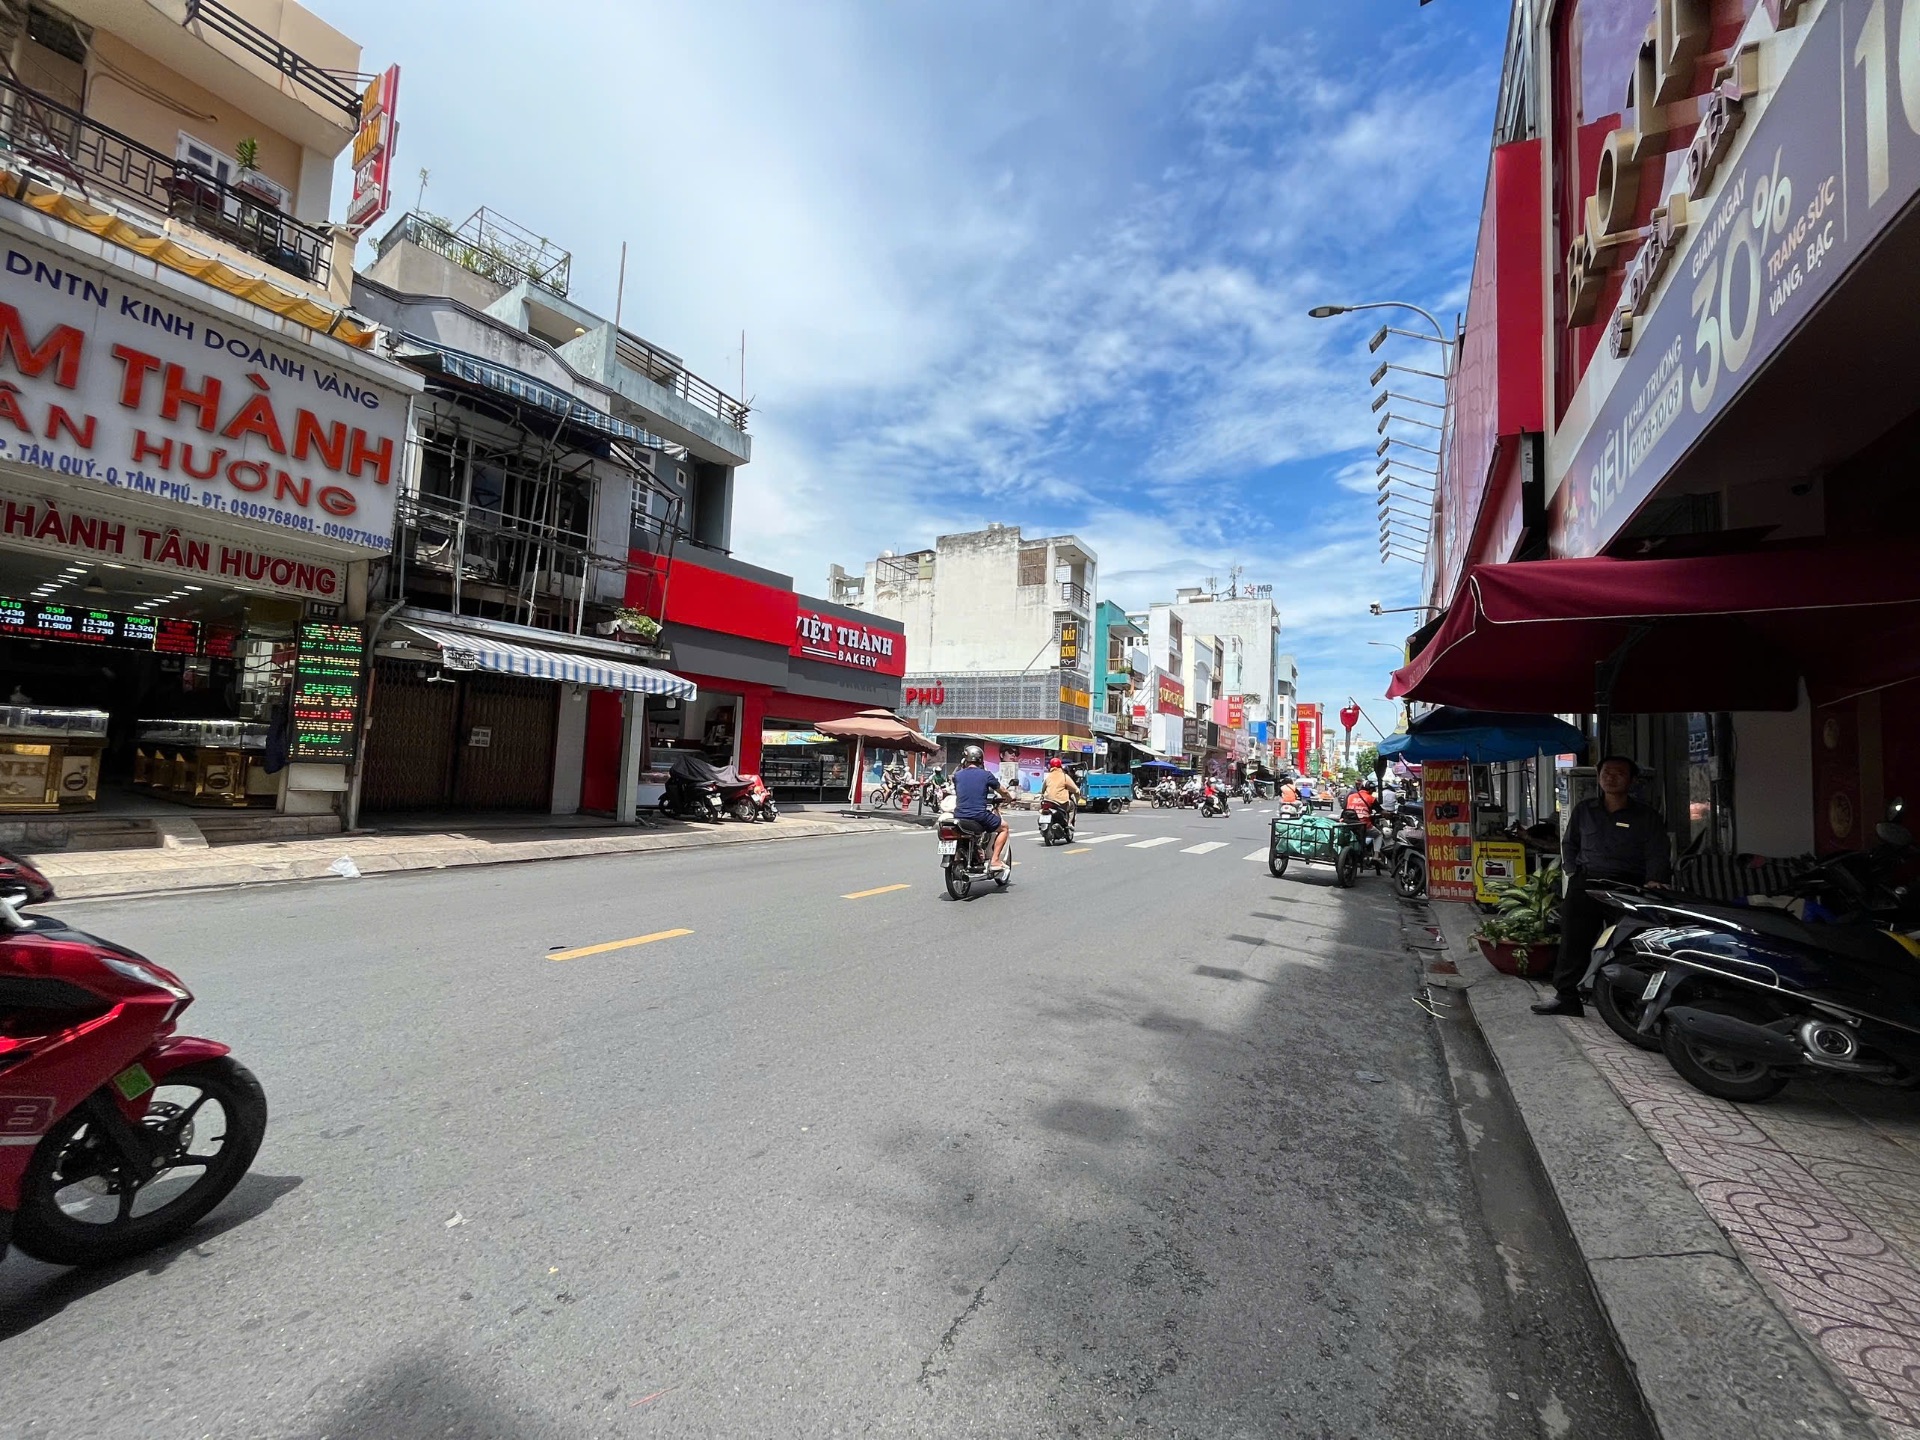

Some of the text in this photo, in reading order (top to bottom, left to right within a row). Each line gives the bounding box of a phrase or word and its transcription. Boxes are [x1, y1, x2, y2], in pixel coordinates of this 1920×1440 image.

[1717, 168, 1747, 236] NGAY
[1767, 174, 1836, 281] TRANG SỨC
[1807, 220, 1834, 268] BẠC
[1690, 144, 1792, 414] 30%
[6, 249, 380, 410] DNTN KINH DOANH VÀNG
[111, 342, 394, 485] THÀNH
[19, 443, 54, 468] TÂN
[126, 469, 156, 492] TÂN
[159, 478, 190, 504] PHÚ
[230, 499, 314, 533] 0909768081
[131, 429, 357, 517] HƯƠNG
[138, 527, 210, 572] TÂN
[219, 546, 337, 595] HƯƠNG
[1257, 584, 1273, 592] MB
[38, 620, 72, 630] 11.900
[124, 623, 154, 632] 13.320
[313, 604, 336, 616] 187
[81, 625, 114, 635] 12.730
[123, 631, 153, 640] 12.930
[836, 626, 892, 656] THÀNH
[838, 650, 878, 668] BAKERY
[1426, 822, 1451, 838] Vespa
